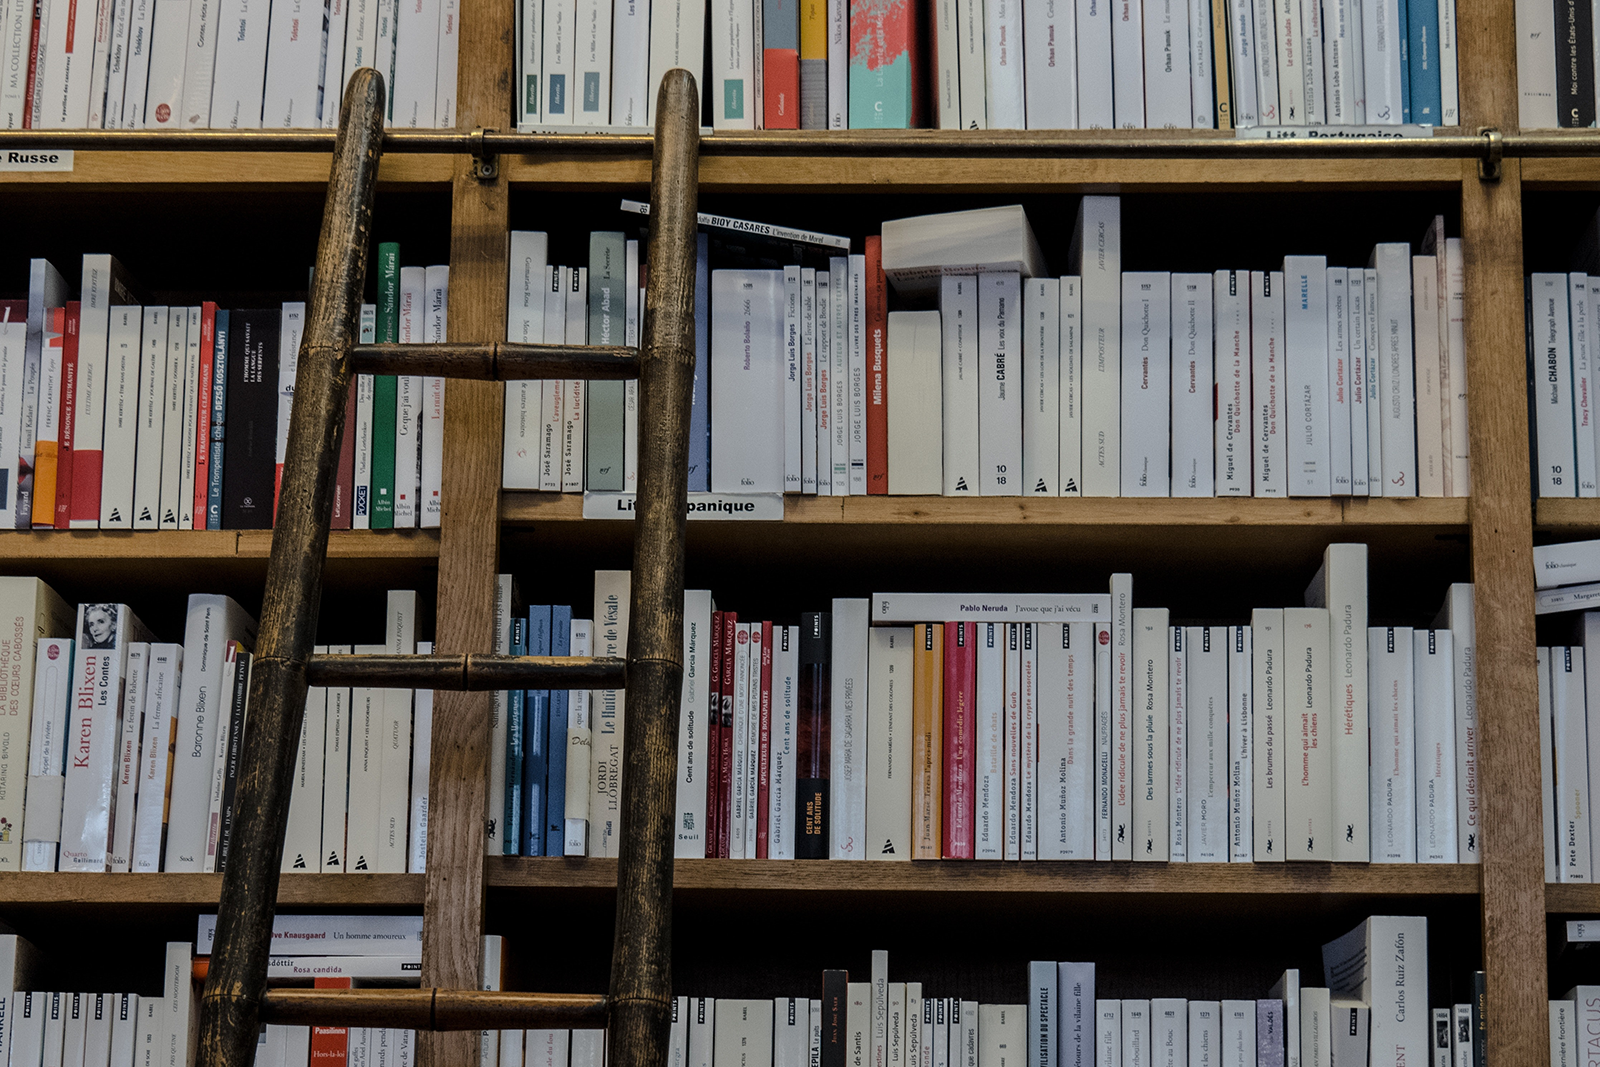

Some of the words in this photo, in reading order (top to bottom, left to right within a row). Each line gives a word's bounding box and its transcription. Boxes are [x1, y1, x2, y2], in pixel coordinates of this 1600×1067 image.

[238, 18, 246, 42] Tolstoï
[1284, 18, 1292, 37] Judas
[1568, 6, 1576, 44] États-Unis
[1163, 30, 1171, 52] Pamuk
[1285, 38, 1292, 47] de
[1285, 48, 1293, 58] cul
[1164, 53, 1172, 72] Orhan
[1287, 59, 1293, 68] Le
[8, 152, 59, 164] Russe
[711, 216, 731, 227] BIOY
[733, 220, 770, 234] CASARES
[772, 228, 799, 240] L'invention
[808, 235, 824, 244] Morel
[384, 252, 395, 278] Márai
[603, 271, 610, 280] La
[382, 282, 395, 314] Sándor
[601, 286, 610, 314] Abad
[804, 296, 812, 312] sable
[1300, 274, 1308, 310] MARELLE
[805, 313, 812, 321] de
[996, 298, 1005, 319] Pamano
[1547, 298, 1555, 317] Avenue
[601, 313, 610, 344] Héctor
[743, 321, 751, 345] Bolaño
[997, 329, 1005, 338] voix
[1548, 319, 1557, 343] Telegraph
[215, 330, 226, 384] KOSZTOLÁNYI
[743, 344, 751, 370] Roberto
[873, 328, 883, 373] Busquets
[997, 341, 1005, 349] Les
[805, 352, 813, 376] Borges
[994, 353, 1005, 382] CABRÉ
[1548, 348, 1557, 382] CHABON
[213, 385, 224, 410] DEZSŐ
[573, 380, 581, 410] lucidité
[873, 374, 882, 406] Milena
[997, 381, 1006, 400] Jaume
[1549, 384, 1558, 404] Michael
[805, 393, 813, 412] Jorge
[1303, 384, 1312, 422] CORTÁZAR
[213, 412, 224, 439] tchèque
[573, 412, 580, 420] La
[566, 420, 574, 456] Saramago
[1304, 425, 1313, 446] JULIO
[211, 442, 222, 486] Trompettiste
[210, 488, 219, 498] Le
[960, 604, 982, 613] Pablo
[980, 604, 1008, 613] Neruda
[1016, 604, 1038, 614] J'avoue
[1040, 606, 1052, 614] que
[1054, 604, 1064, 614] j'ai
[1066, 604, 1082, 613] vécu
[1118, 592, 1126, 626] Montero
[1343, 604, 1352, 635] Padura
[13, 616, 24, 662] CABOSSÉS
[689, 622, 698, 653] Márquez
[1118, 628, 1126, 646] Rosa
[688, 655, 697, 678] García
[1117, 652, 1126, 676] revoir
[1265, 648, 1273, 674] Padura
[1304, 648, 1313, 672] Padura
[1343, 637, 1353, 678] Leonardo
[1461, 646, 1473, 678] Padura
[11, 664, 21, 696] CŒURS
[78, 656, 97, 709] Blixen
[99, 656, 110, 688] Contes
[1118, 675, 1126, 684] te
[1146, 660, 1154, 692] Montero
[97, 690, 107, 706] Les
[194, 686, 207, 713] Blixen
[687, 680, 696, 703] Gabriel
[1117, 686, 1127, 713] jamais
[1146, 693, 1154, 710] Rosa
[1265, 676, 1273, 710] Leonardo
[1304, 674, 1313, 708] Leonardo
[1462, 677, 1474, 722] Leonardo
[9, 698, 19, 716] DES
[1343, 684, 1355, 736] Hérétiques
[687, 710, 695, 739] solitude
[1100, 710, 1108, 745] NAUFRAGÉS
[1117, 712, 1127, 730] plus
[1146, 715, 1156, 733] pluie
[1265, 715, 1275, 736] passé
[1300, 712, 1309, 737] aimait
[1309, 712, 1318, 737] chiens
[74, 718, 92, 770] Karen
[192, 715, 205, 758] Baronne
[686, 740, 694, 750] de
[1117, 742, 1126, 752] de
[1119, 730, 1126, 741] ne
[1266, 737, 1273, 747] du
[1300, 739, 1311, 751] qui
[1309, 738, 1318, 748] les
[1464, 728, 1475, 757] arriver
[597, 760, 608, 796] JORDI
[608, 744, 619, 810] LLOBREGAT
[686, 766, 694, 784] Cent
[1059, 758, 1067, 783] Molina
[1117, 754, 1126, 782] ridicule
[1146, 761, 1154, 786] larmes
[1300, 752, 1309, 786] L'homme
[1464, 760, 1477, 797] désirait
[1058, 786, 1067, 810] Muñoz
[1117, 784, 1126, 806] L'idée
[1146, 787, 1154, 800] Des
[806, 802, 814, 816] ANS
[814, 792, 822, 826] SOLITUDE
[1465, 798, 1478, 814] qui
[805, 817, 814, 834] CENT
[1059, 813, 1067, 844] Antonio
[1466, 813, 1477, 826] Ce
[284, 931, 326, 941] Knausgaard
[333, 932, 344, 940] Un
[346, 932, 371, 940] homme
[373, 932, 406, 940] amoureux
[1394, 932, 1405, 962] Zafón
[292, 966, 310, 974] Rosa
[313, 965, 342, 974] candida
[1395, 965, 1405, 986] Ruiz
[875, 978, 885, 1020] Sepúlveda
[1395, 990, 1405, 1022] Carlos
[314, 1027, 346, 1035] Paasilinna
[875, 1022, 884, 1038] Luis
[312, 1050, 346, 1058] Hors-la-loi
